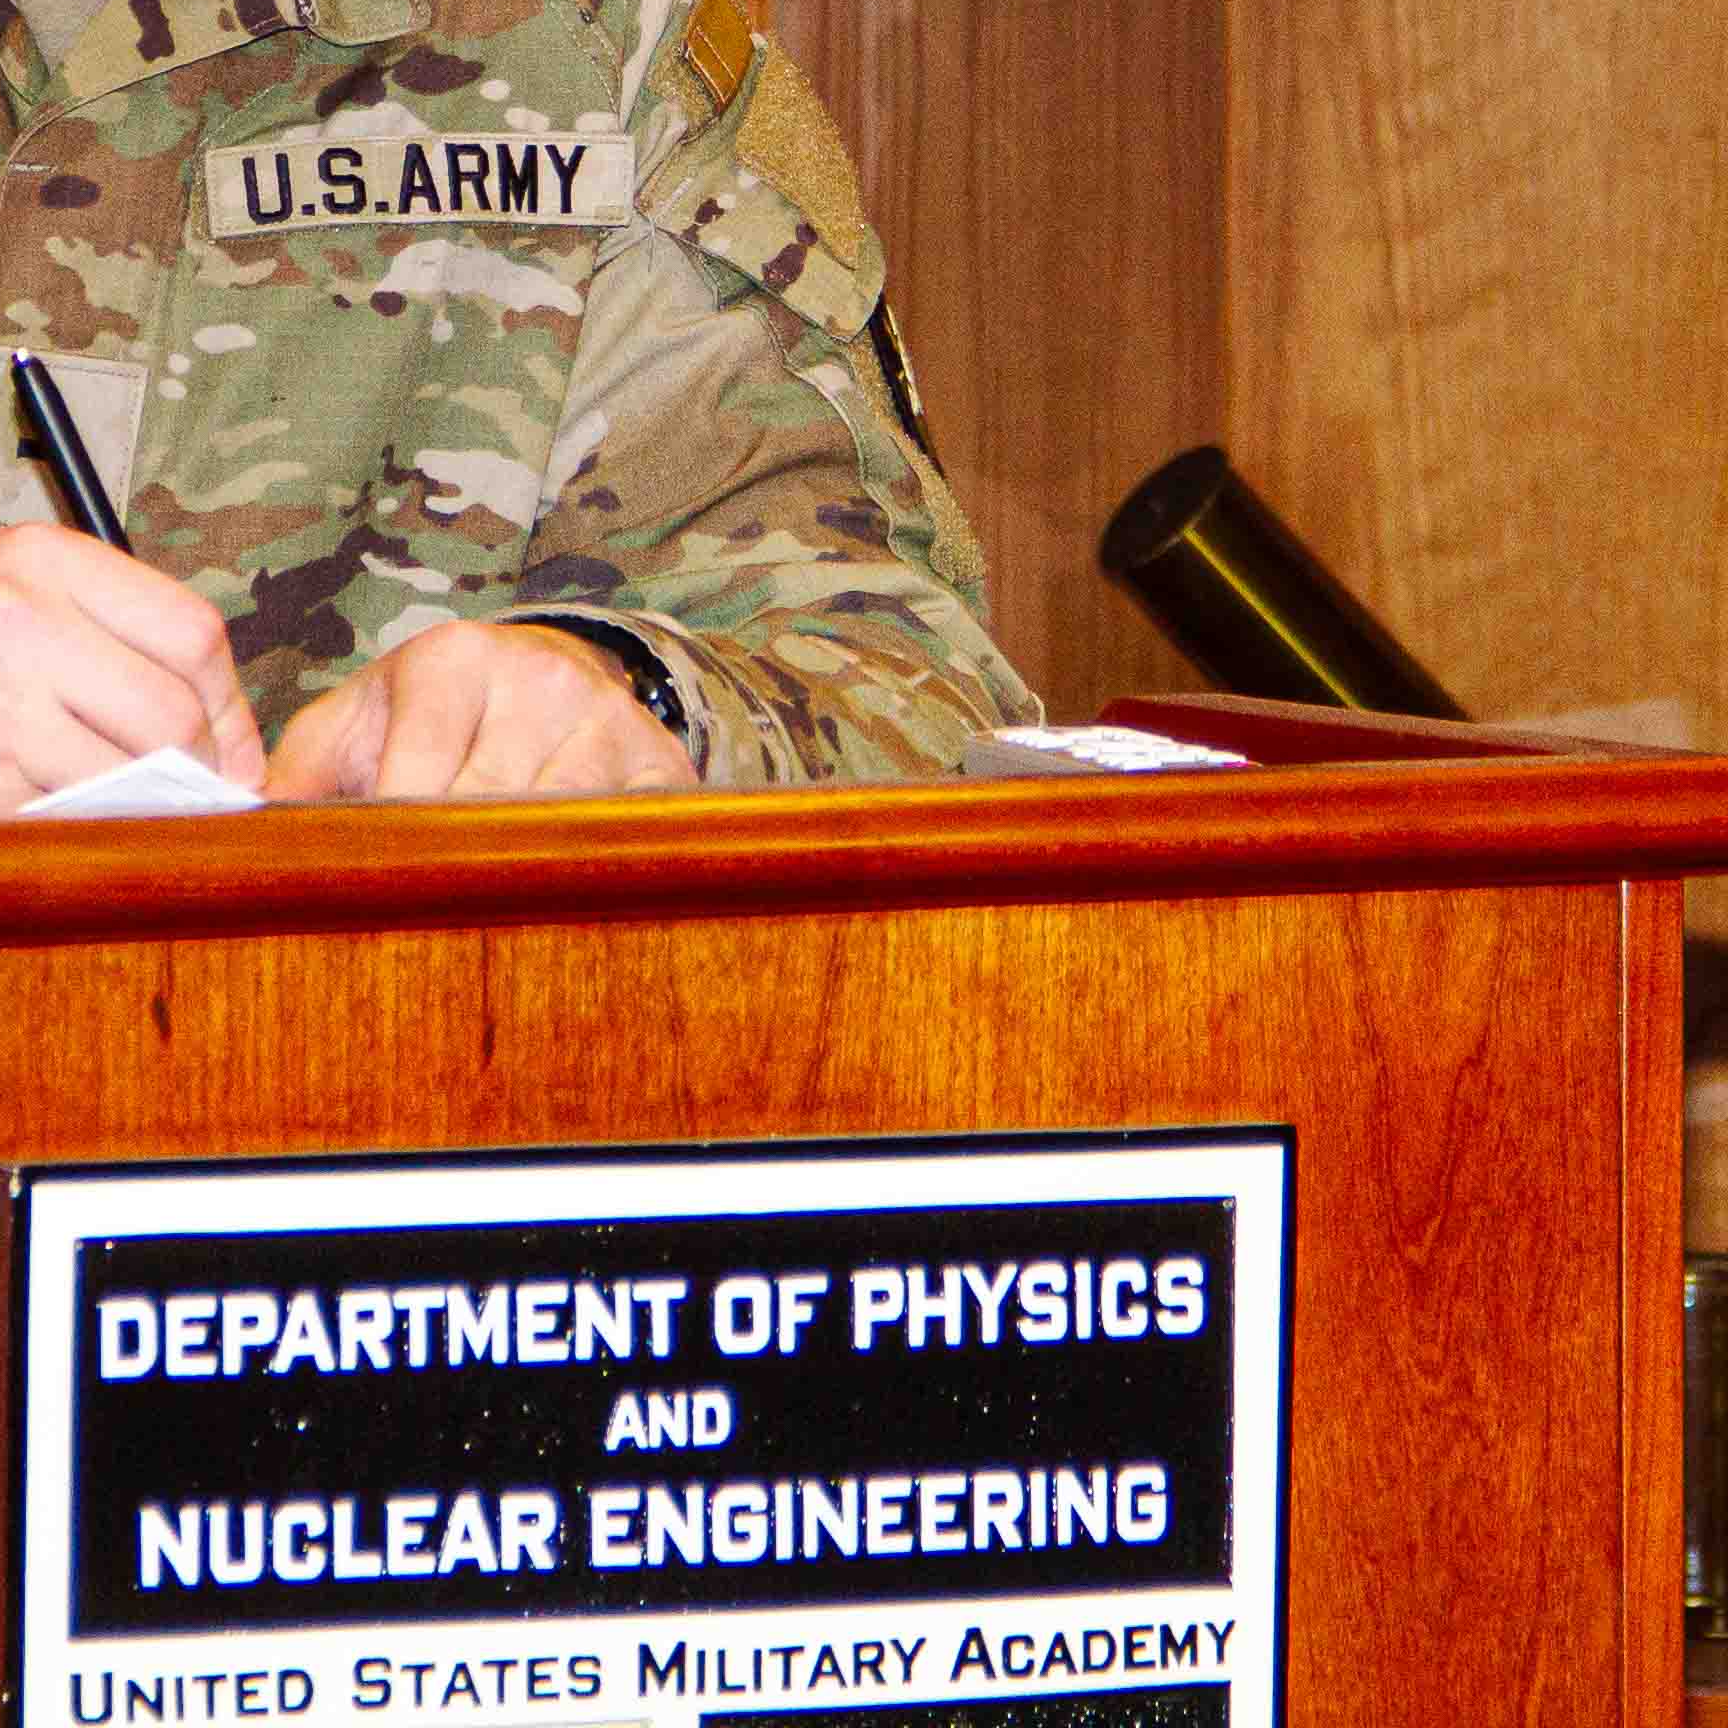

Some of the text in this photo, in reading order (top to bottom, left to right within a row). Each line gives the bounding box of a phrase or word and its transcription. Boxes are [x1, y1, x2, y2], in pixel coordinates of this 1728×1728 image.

[98, 1257, 1206, 1380] DEPARTMENT OF PHYSICS
[603, 1388, 732, 1452] AND
[139, 1464, 1169, 1588] NUCLEAR ENGINEERING
[70, 1618, 1236, 1725] UNITED STATES MILITARY ACADEMY
